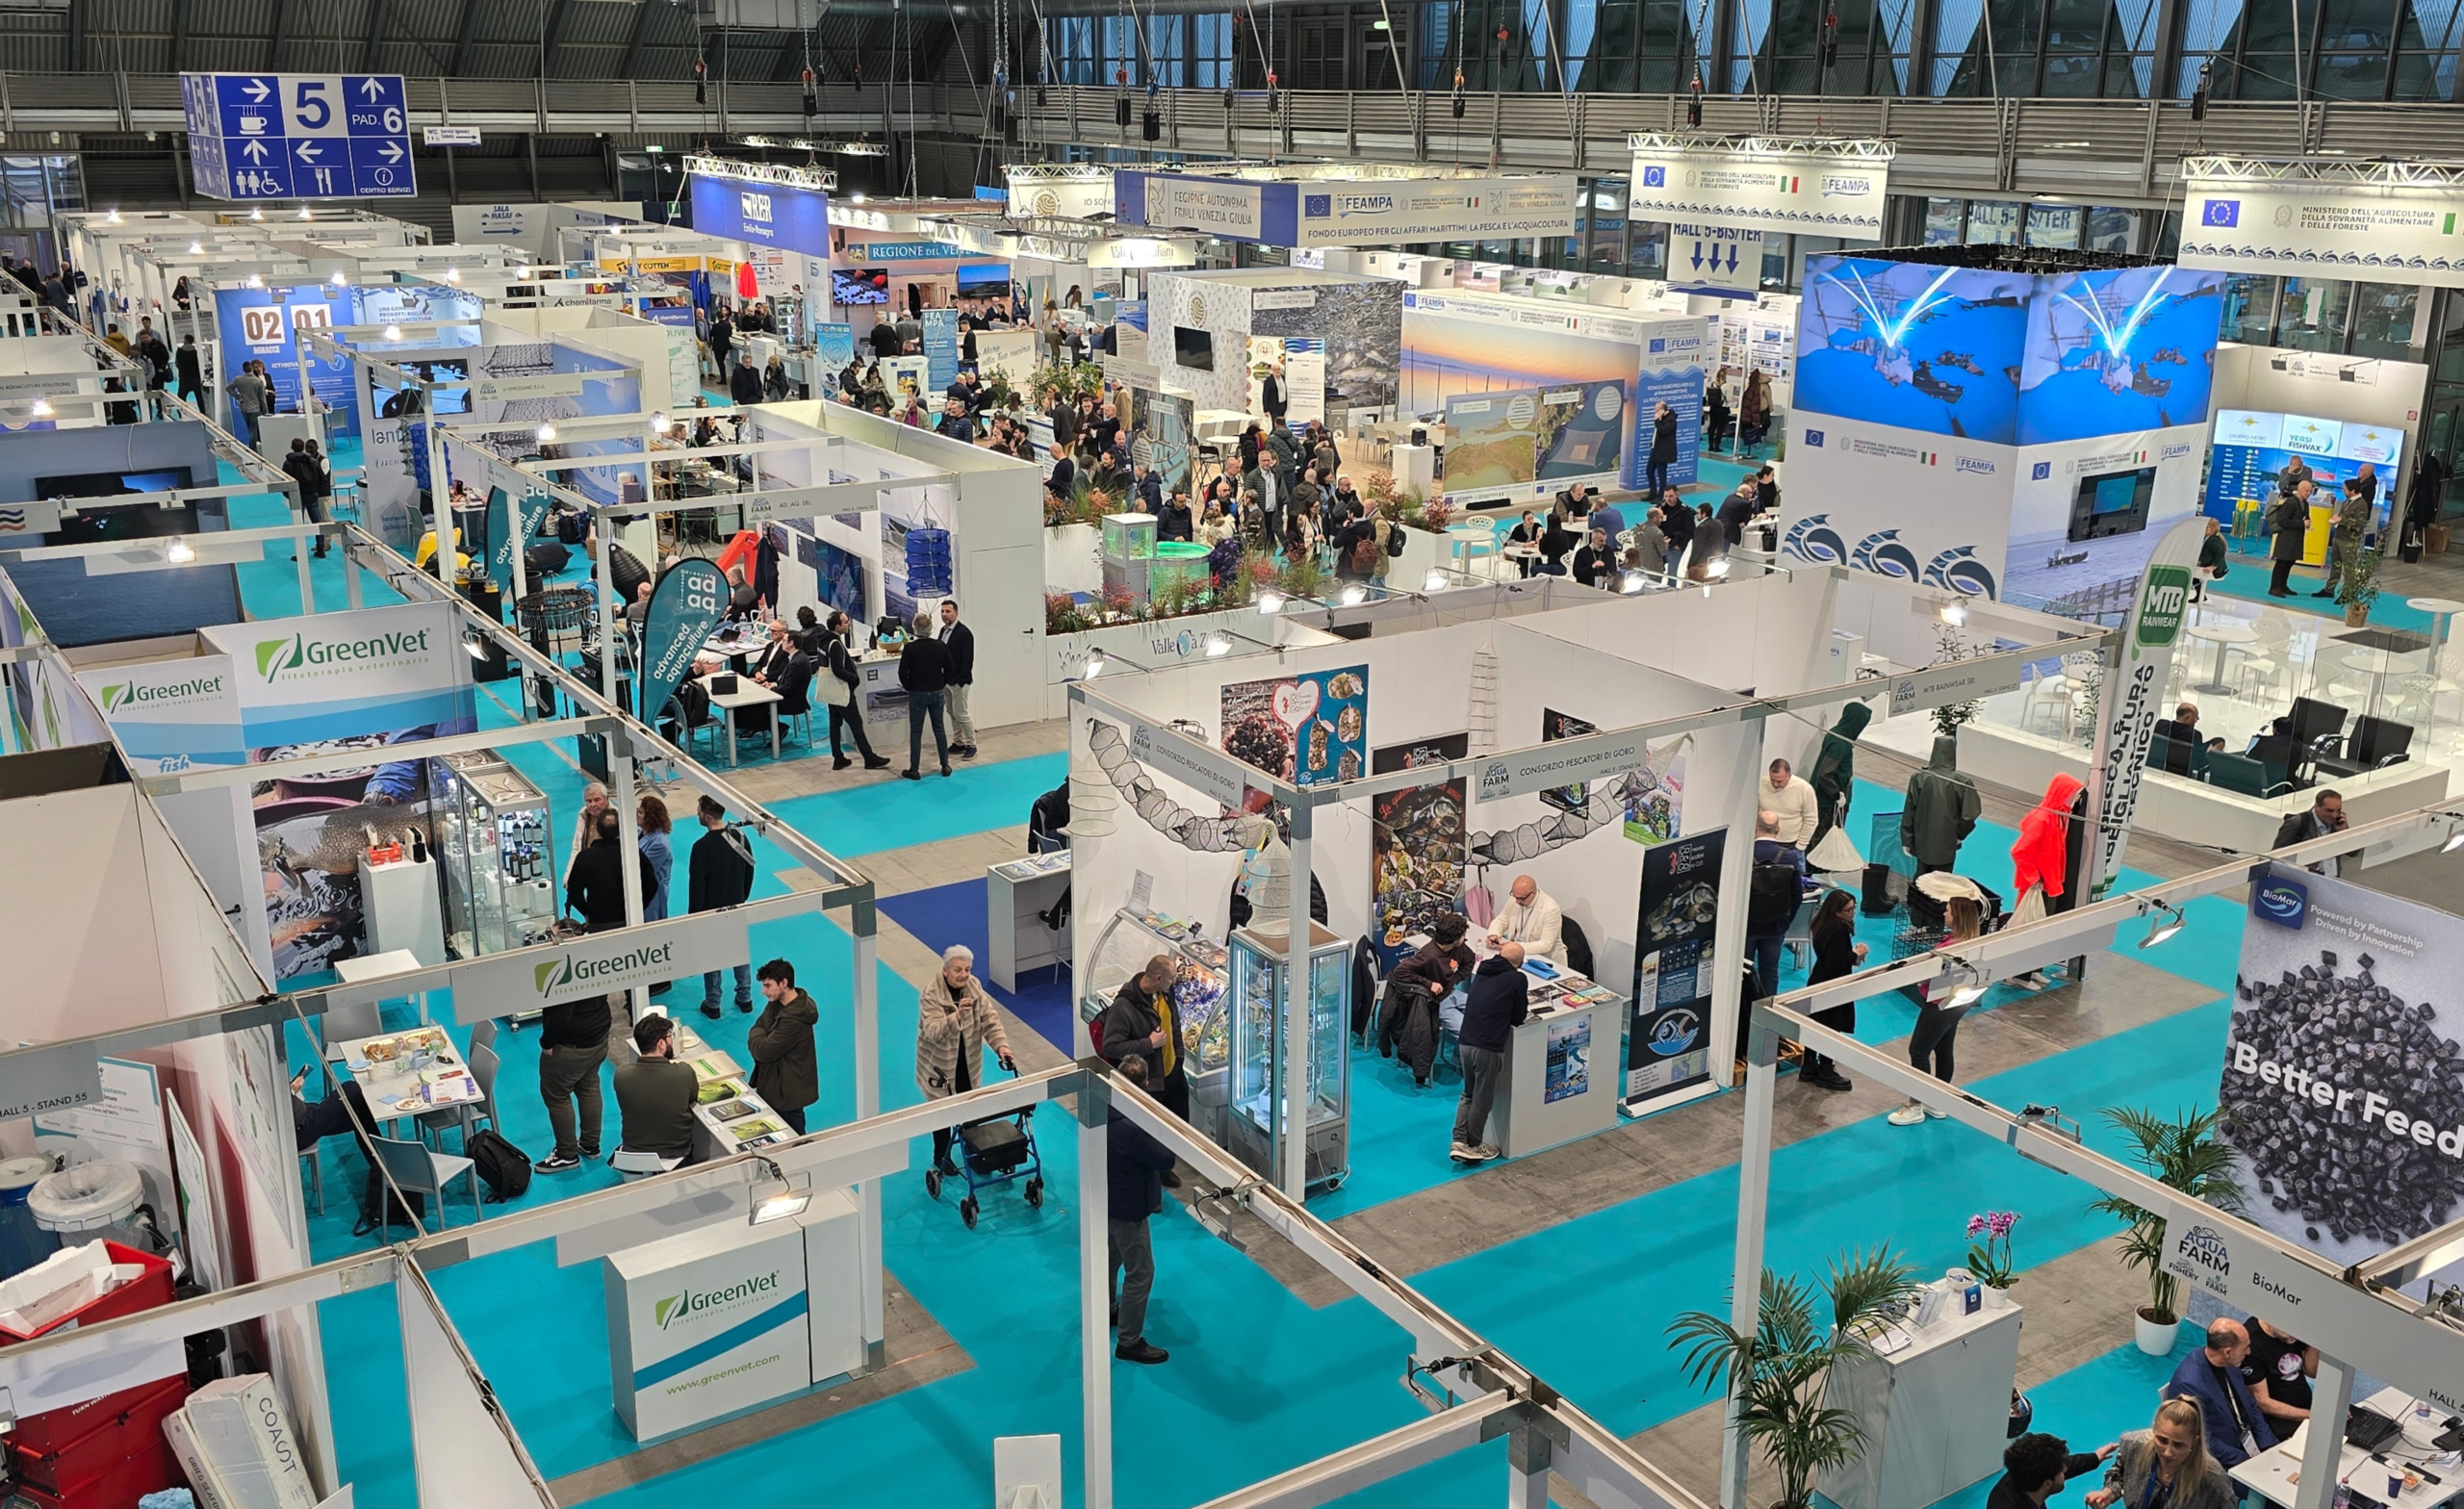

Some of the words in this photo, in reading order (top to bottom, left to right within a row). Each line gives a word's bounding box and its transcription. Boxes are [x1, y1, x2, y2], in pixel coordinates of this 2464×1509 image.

[295, 82, 330, 130] 5
[352, 114, 380, 126] PAD.
[383, 107, 403, 133] 6
[1829, 179, 1870, 192] FEAMPA
[1174, 191, 1204, 205] REGIONE
[1206, 193, 1248, 209] AUTONOMA
[1346, 195, 1394, 210] FEAMPA
[1174, 206, 1195, 219] FRIULI
[1197, 208, 1227, 222] VENEZIA
[1228, 211, 1252, 225] GIULIA
[2302, 206, 2348, 215] MINISTERO
[2351, 206, 2435, 218] DELL'AGRICOLTURA
[2327, 213, 2375, 224] SOVRANITÀ
[2378, 217, 2435, 226] ALIMENTARE
[1308, 228, 1337, 239] FONDO
[1338, 227, 1374, 237] EUROPEO
[1375, 226, 1390, 236] PER
[1390, 225, 1402, 235] GLI
[1403, 224, 1428, 234] AFFARI
[1429, 222, 1469, 233] MARITTIMI,
[1470, 222, 1479, 231] LA
[1479, 221, 1502, 231] PESCA
[1502, 221, 1506, 230] E
[1507, 219, 1569, 231] L'ACQUACOLTURA
[1674, 222, 1701, 238] HALL
[1704, 224, 1761, 243] 5-BIS/TER
[873, 245, 924, 258] REGIONE
[643, 262, 670, 270] COTTEN
[565, 297, 612, 306] chemifarma
[1421, 296, 1445, 308] FEAMPA
[245, 311, 282, 341] 02
[1672, 338, 1701, 348] FEAMPA
[2288, 442, 2322, 452] FISHVAX
[2290, 434, 2312, 444] YERSI
[2165, 444, 2191, 455] FEAMPA
[1961, 458, 1995, 473] FEAMPA
[688, 575, 716, 594] ad
[688, 594, 716, 615] aq
[2144, 584, 2184, 613] MTB
[2142, 615, 2177, 627] RAINWEAR
[307, 627, 429, 665] GreenVet
[654, 622, 691, 680] advanced
[665, 620, 708, 683] aquaculture
[1151, 638, 1175, 655] Valle
[281, 662, 353, 681] fitoterapia
[359, 656, 429, 673] veterinaria
[137, 676, 222, 702] GreenVet
[1923, 684, 1937, 694] MTB
[1938, 678, 1966, 692] RAINWEAR
[1967, 677, 1976, 685] SRL
[119, 702, 170, 713] fitoterapia
[173, 695, 223, 706] veterinaria
[1894, 691, 1915, 703] FARM
[1134, 735, 1150, 750] FARM
[160, 754, 191, 774] fish
[1157, 745, 1186, 766] CONSORZIO
[1187, 759, 1212, 779] PESCATORI
[1213, 772, 1219, 780] DI
[1219, 777, 1235, 790] GORO
[1520, 760, 1564, 777] CONSORZIO
[1565, 754, 1603, 768] PESCATORI
[1613, 746, 1635, 759] GORO
[2127, 710, 2155, 824] TECNICO
[1483, 774, 1510, 788] FARM
[1485, 767, 1508, 779] AQUA
[2262, 888, 2298, 908] BioMar
[2310, 904, 2352, 925] Powered
[2353, 918, 2367, 932] by
[2368, 923, 2424, 950] Partnership
[2315, 917, 2347, 935] Driven
[2348, 928, 2361, 942] by
[2362, 930, 2414, 958] Innovation
[575, 942, 672, 980] GreenVet
[554, 978, 612, 995] fitoterapia
[616, 965, 673, 983] veterinaria
[103, 1086, 127, 1096] sistema
[2233, 1040, 2354, 1113] Better
[2362, 1090, 2464, 1160] Feed
[22, 1103, 29, 1113] 5
[38, 1095, 72, 1110] STAND
[75, 1092, 88, 1102] 55
[2183, 1229, 2228, 1261] AQUA
[2178, 1240, 2230, 1276] FARM
[2168, 1262, 2199, 1283] FISHERY
[691, 1271, 778, 1311] GreenVet
[2204, 1281, 2227, 1296] FARM
[2252, 1271, 2302, 1307] BioMar
[673, 1308, 724, 1326] fitoterapia
[728, 1292, 779, 1310] veterinaria
[666, 1354, 781, 1395] www.greenvet.com
[71, 1400, 90, 1417] TURN
[2428, 1388, 2457, 1411] HALL
[259, 1396, 297, 1474] COAST
[188, 1455, 204, 1483] GRIEG
